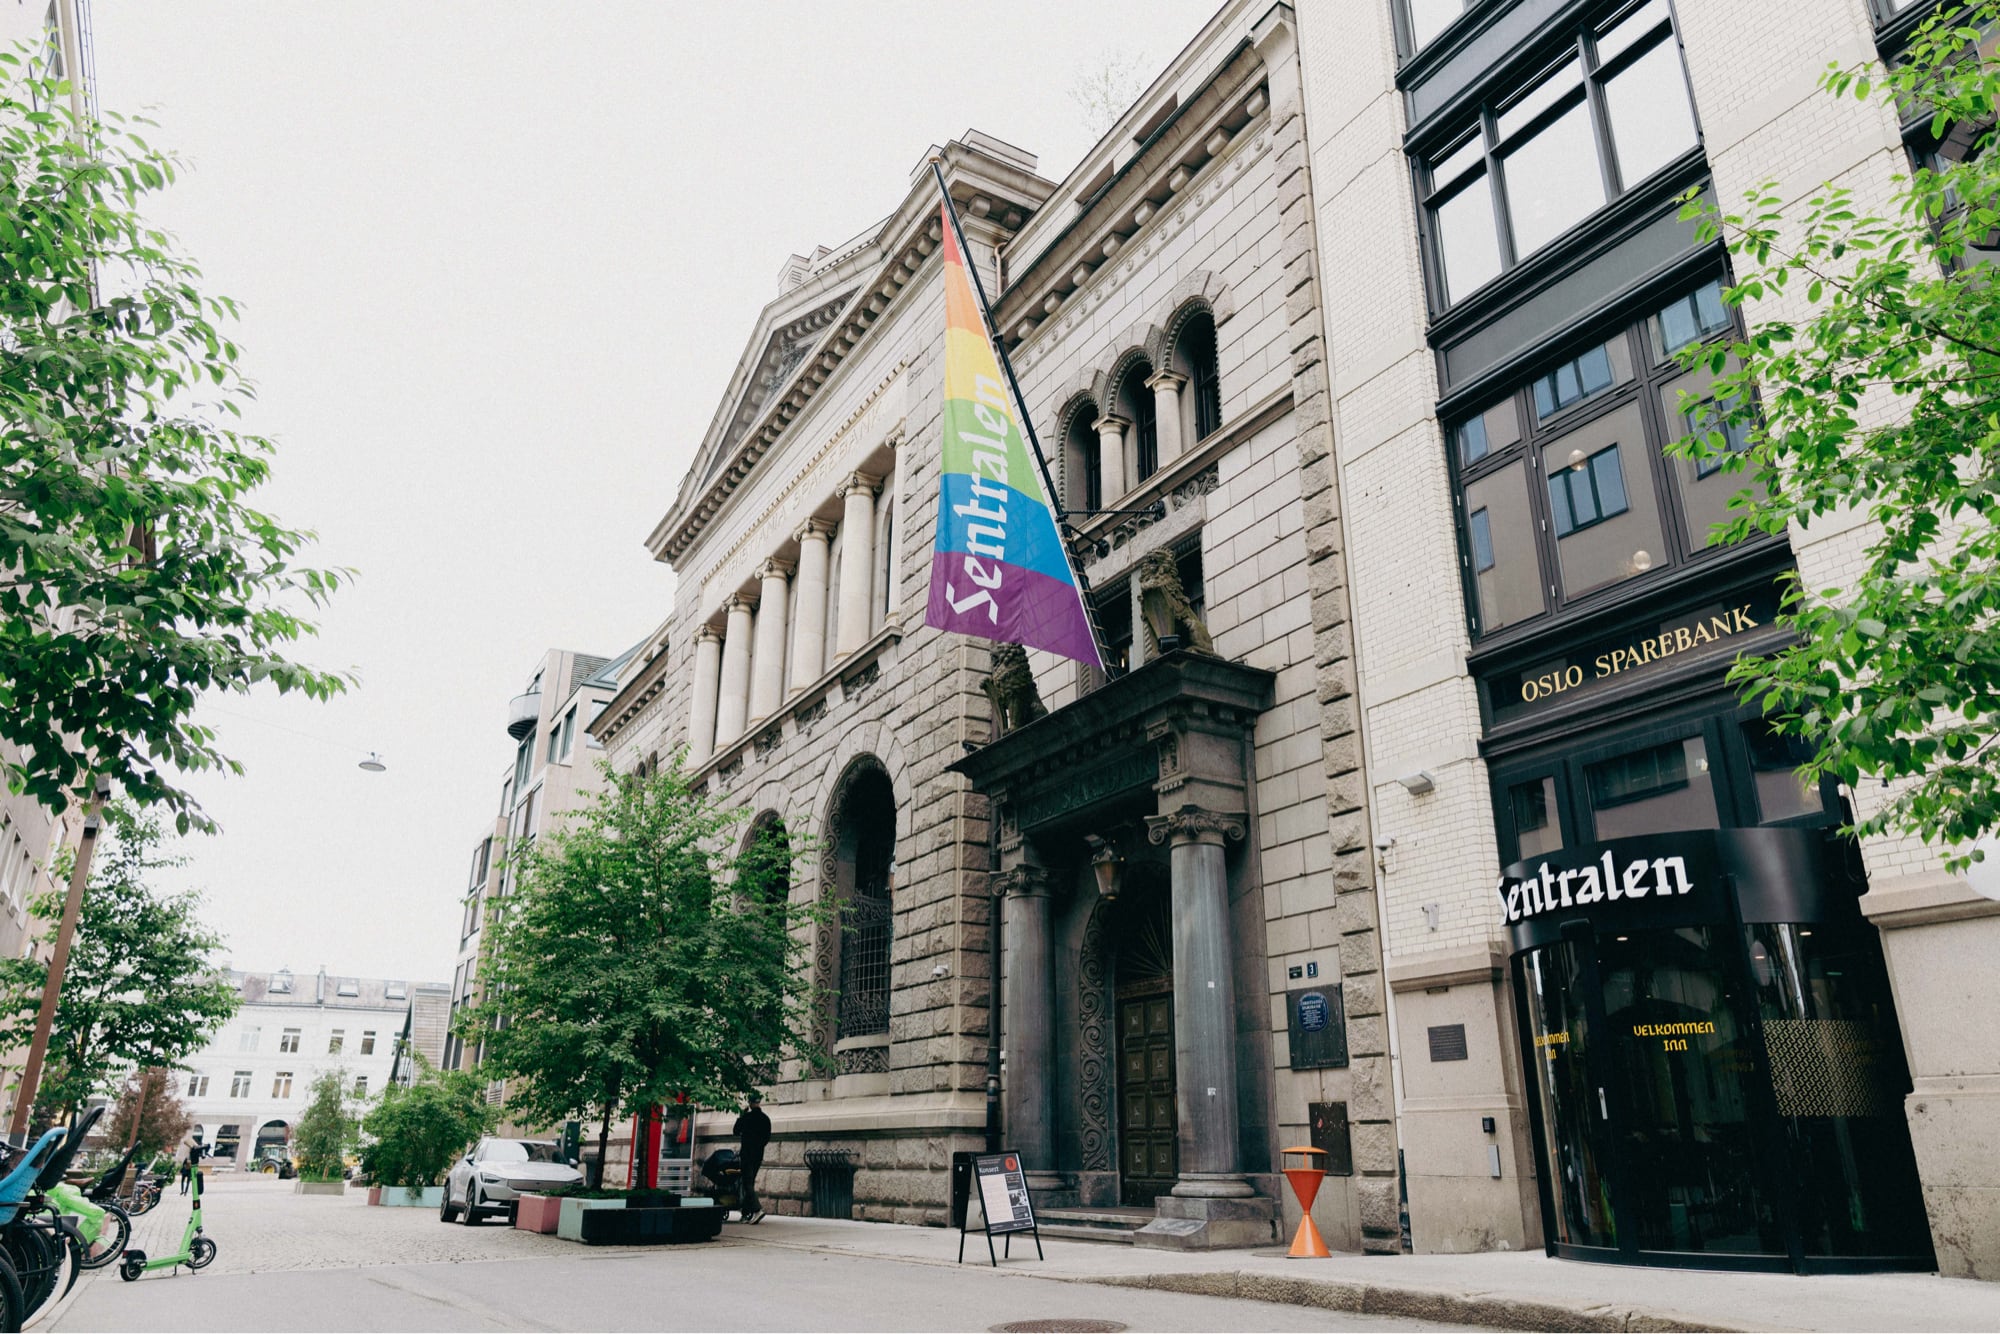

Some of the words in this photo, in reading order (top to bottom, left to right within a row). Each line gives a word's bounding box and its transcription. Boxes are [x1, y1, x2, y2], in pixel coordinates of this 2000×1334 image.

[945, 374, 1008, 626] Sentralen
[1521, 665, 1583, 703] OSLO
[1595, 604, 1759, 680] SPAREBANK
[1309, 964, 1314, 974] 3
[1633, 1021, 1715, 1036] VELKOMMEN
[1663, 1038, 1688, 1052] INN
[979, 1166, 999, 1174] Konsert
